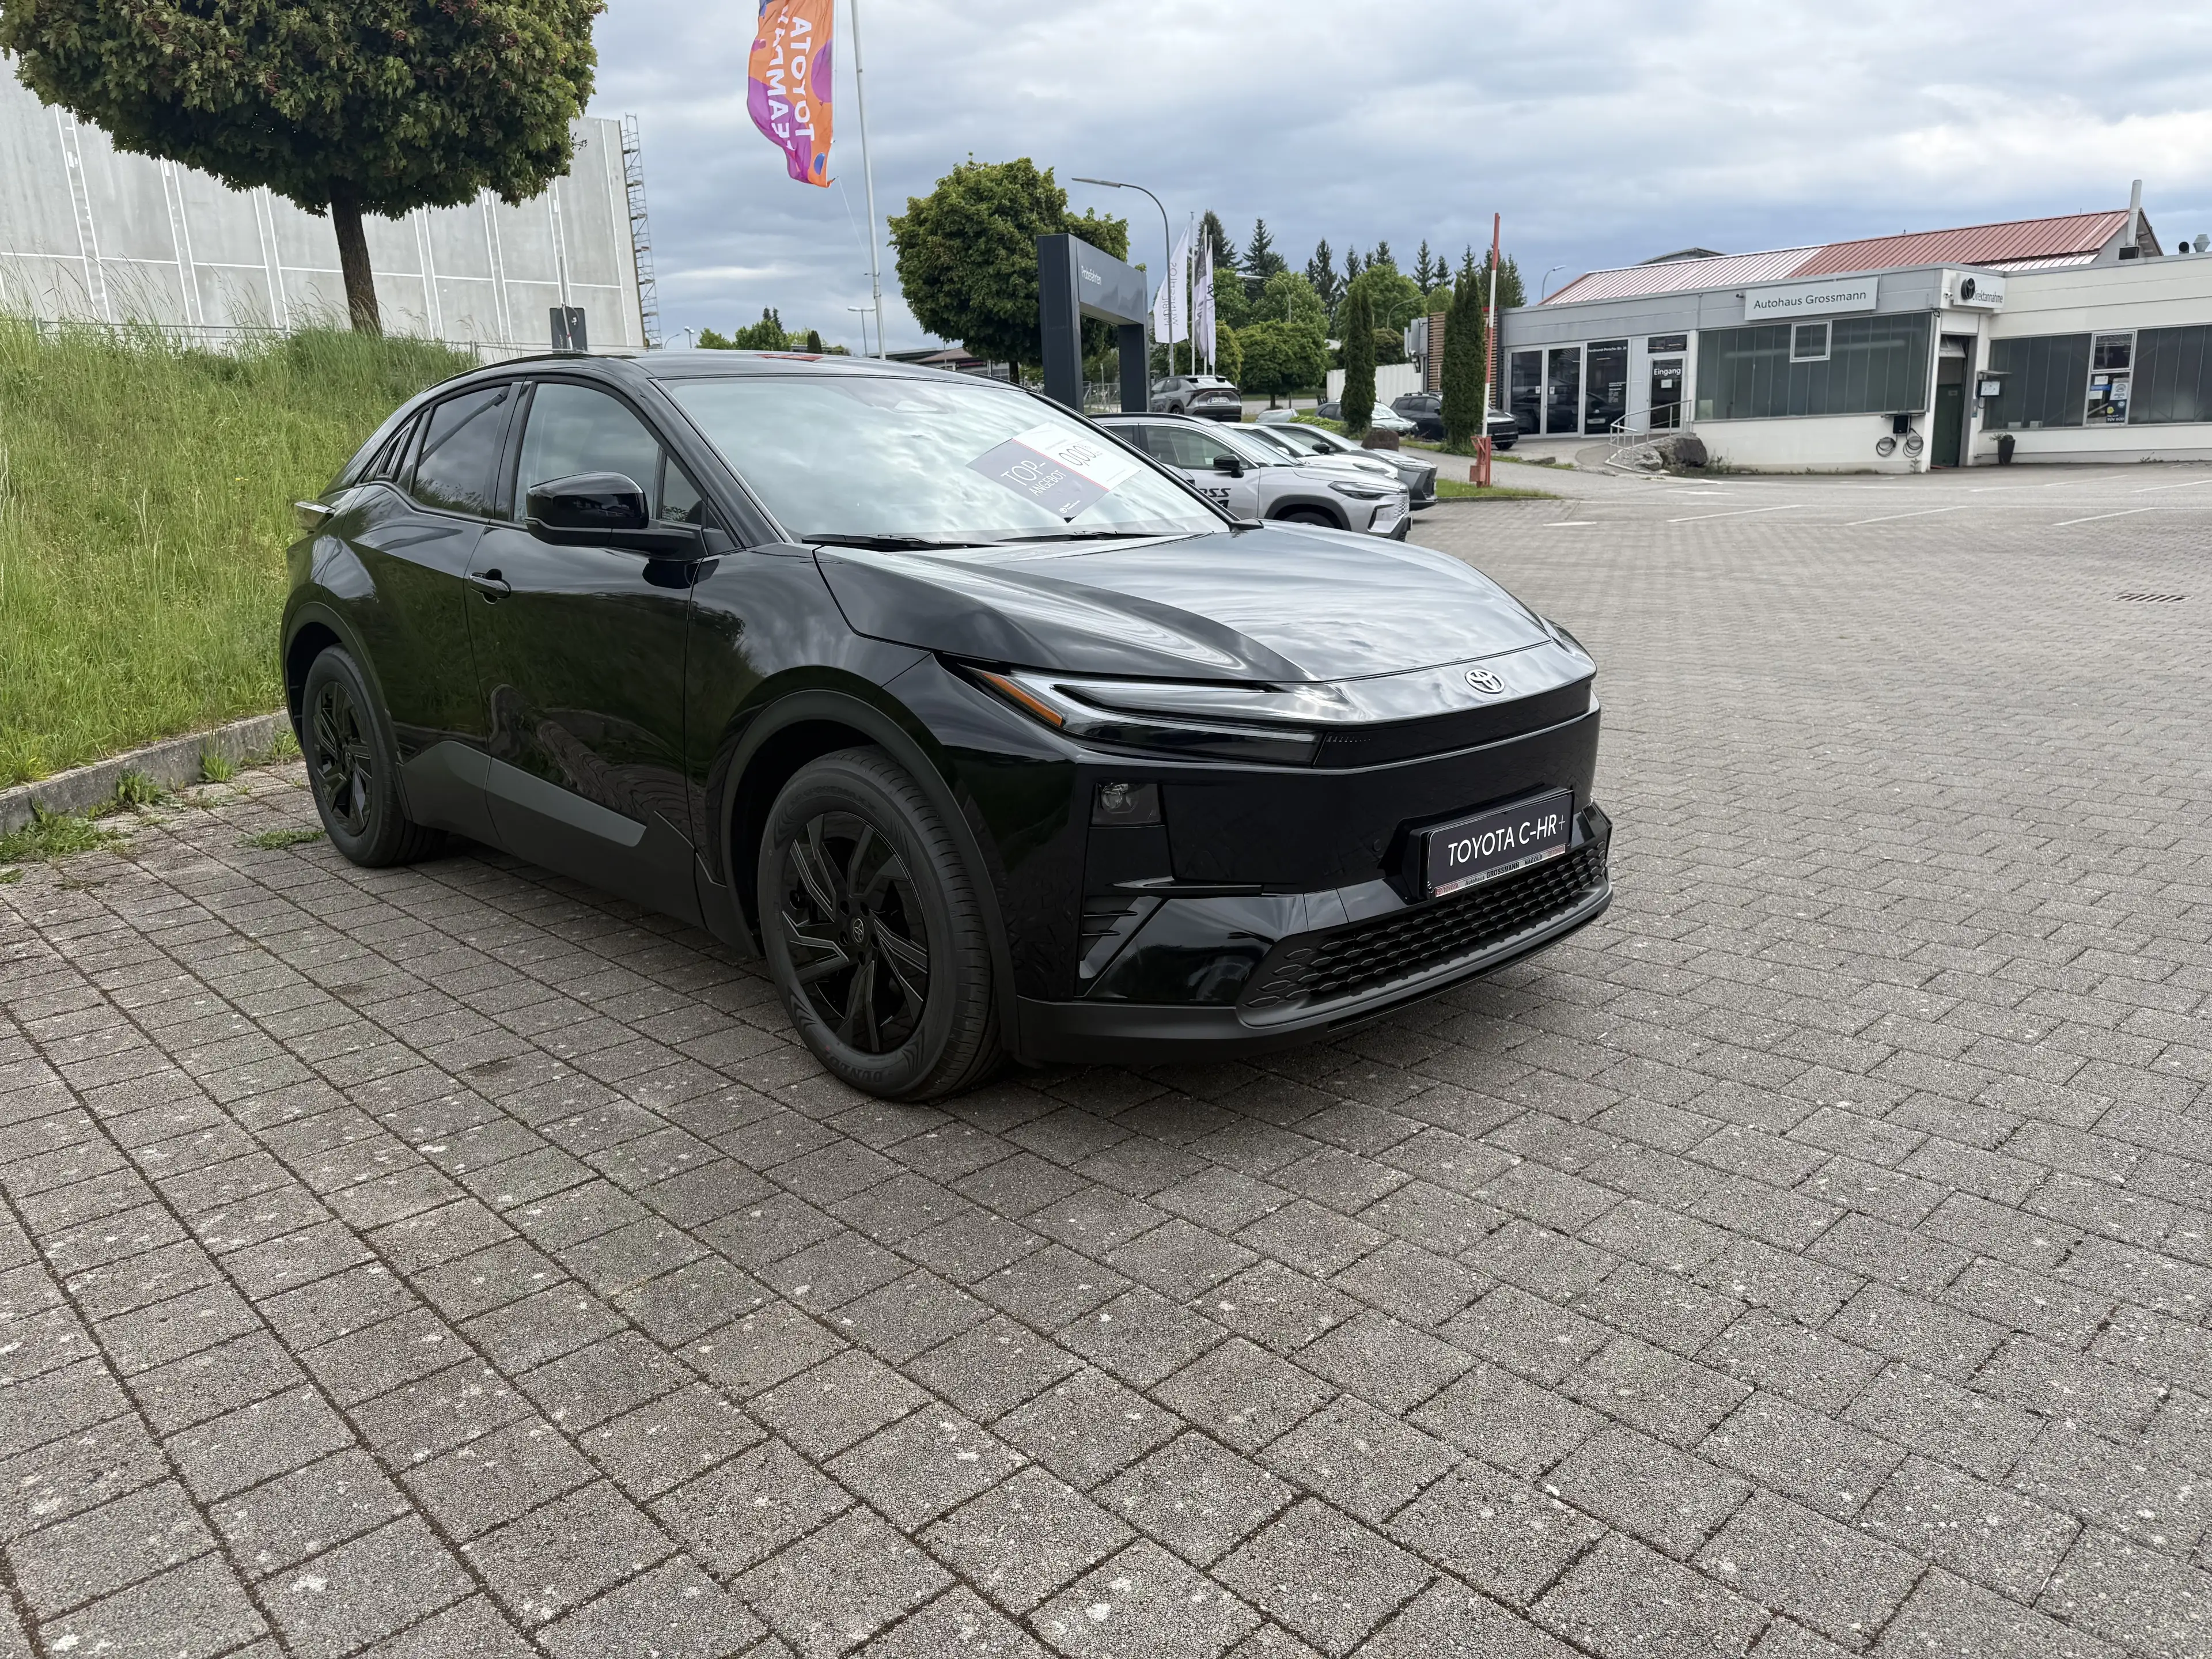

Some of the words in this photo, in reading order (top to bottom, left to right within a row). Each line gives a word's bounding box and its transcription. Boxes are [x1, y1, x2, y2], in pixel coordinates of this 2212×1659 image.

[1753, 297, 1802, 309] Autohaus
[1805, 291, 1866, 305] Grossmann
[1654, 368, 1681, 376] Eingang
[1059, 445, 1097, 466] 0,00
[1001, 460, 1046, 486] TOP-
[1029, 469, 1067, 497] ANGEBOT
[1448, 827, 1515, 866] TOYOTA
[1518, 814, 1566, 845] C-HR+
[1442, 884, 1459, 893] TOYOTA
[1465, 875, 1485, 886] Autohaus
[1486, 862, 1520, 879] GROSSMANN
[1524, 855, 1543, 866] NAGOLD
